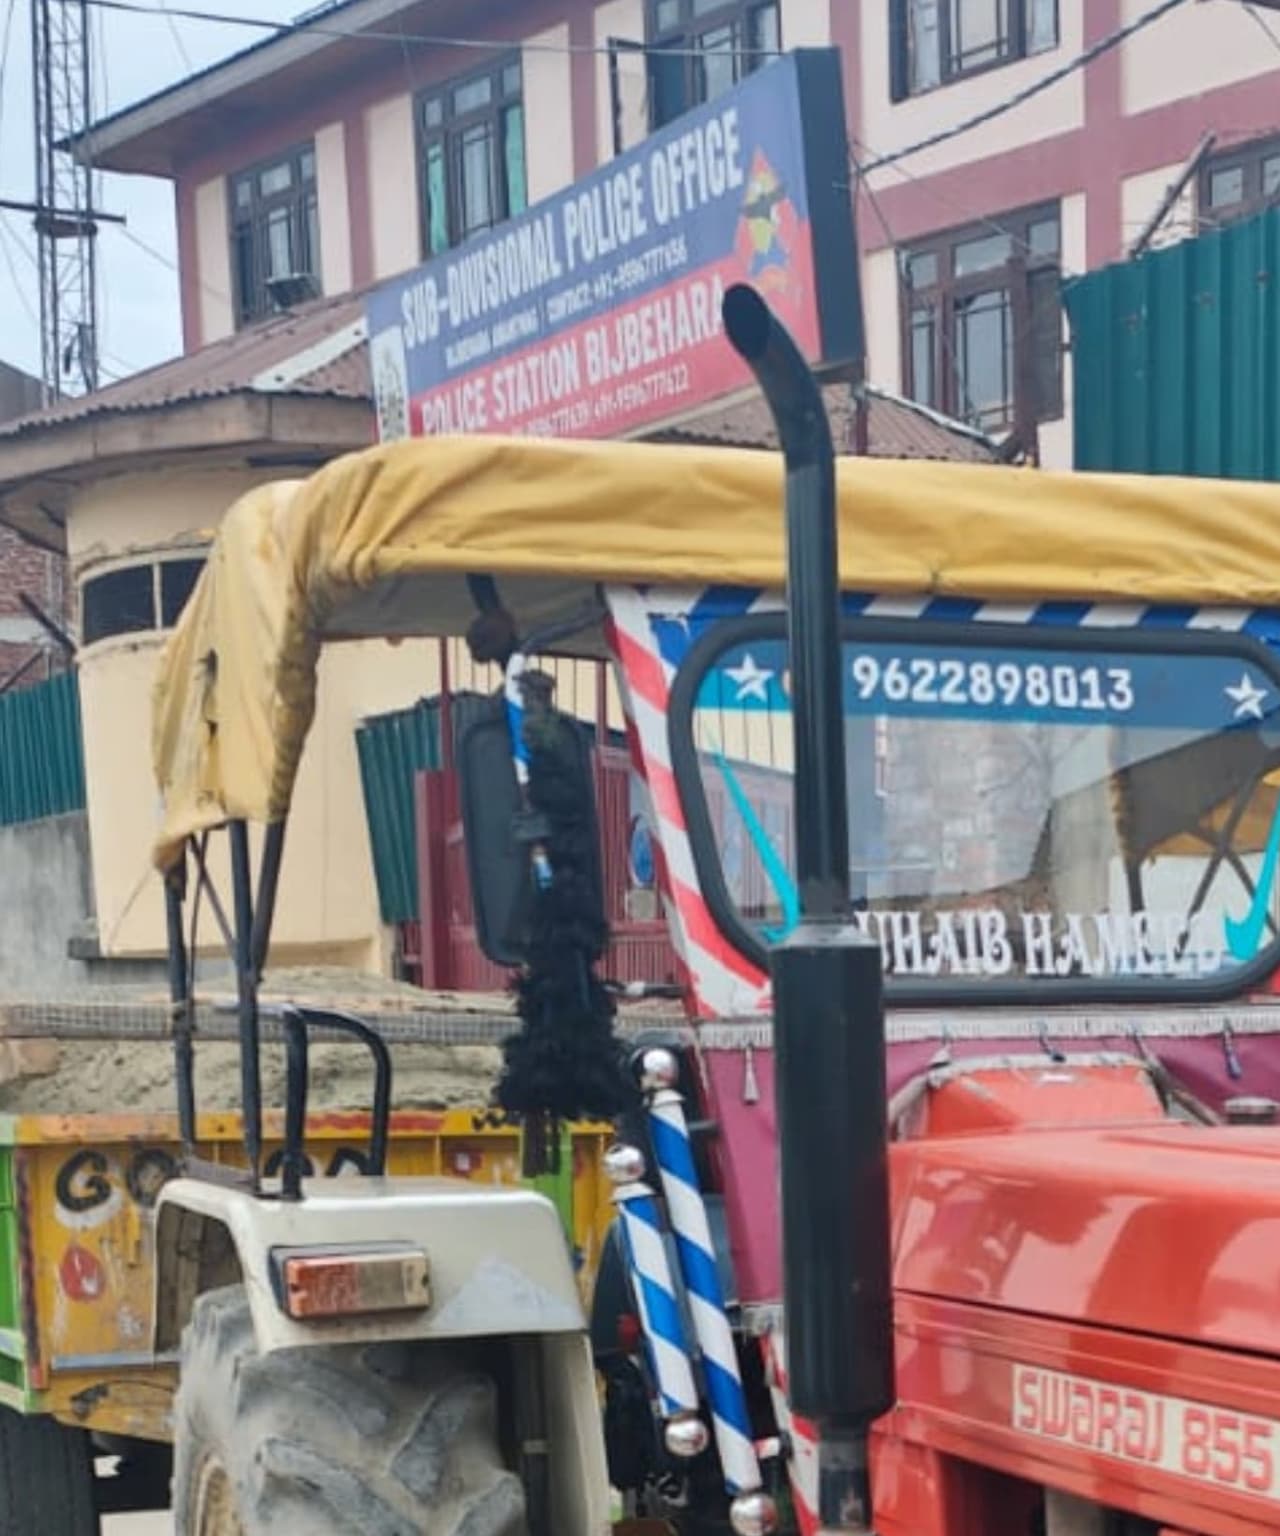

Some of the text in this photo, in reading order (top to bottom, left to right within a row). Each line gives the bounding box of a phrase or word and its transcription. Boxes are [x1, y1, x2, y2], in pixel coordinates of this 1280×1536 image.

[402, 212, 561, 348] SUB-DIVISIONAL
[563, 162, 647, 271] POLICE
[651, 107, 743, 226] OFFICE
[423, 377, 487, 434] POLICE
[492, 339, 580, 422] STATION
[585, 275, 724, 386] BIJBEHARA
[852, 655, 1135, 711] 9622898013
[1181, 1406, 1273, 1491] 855
